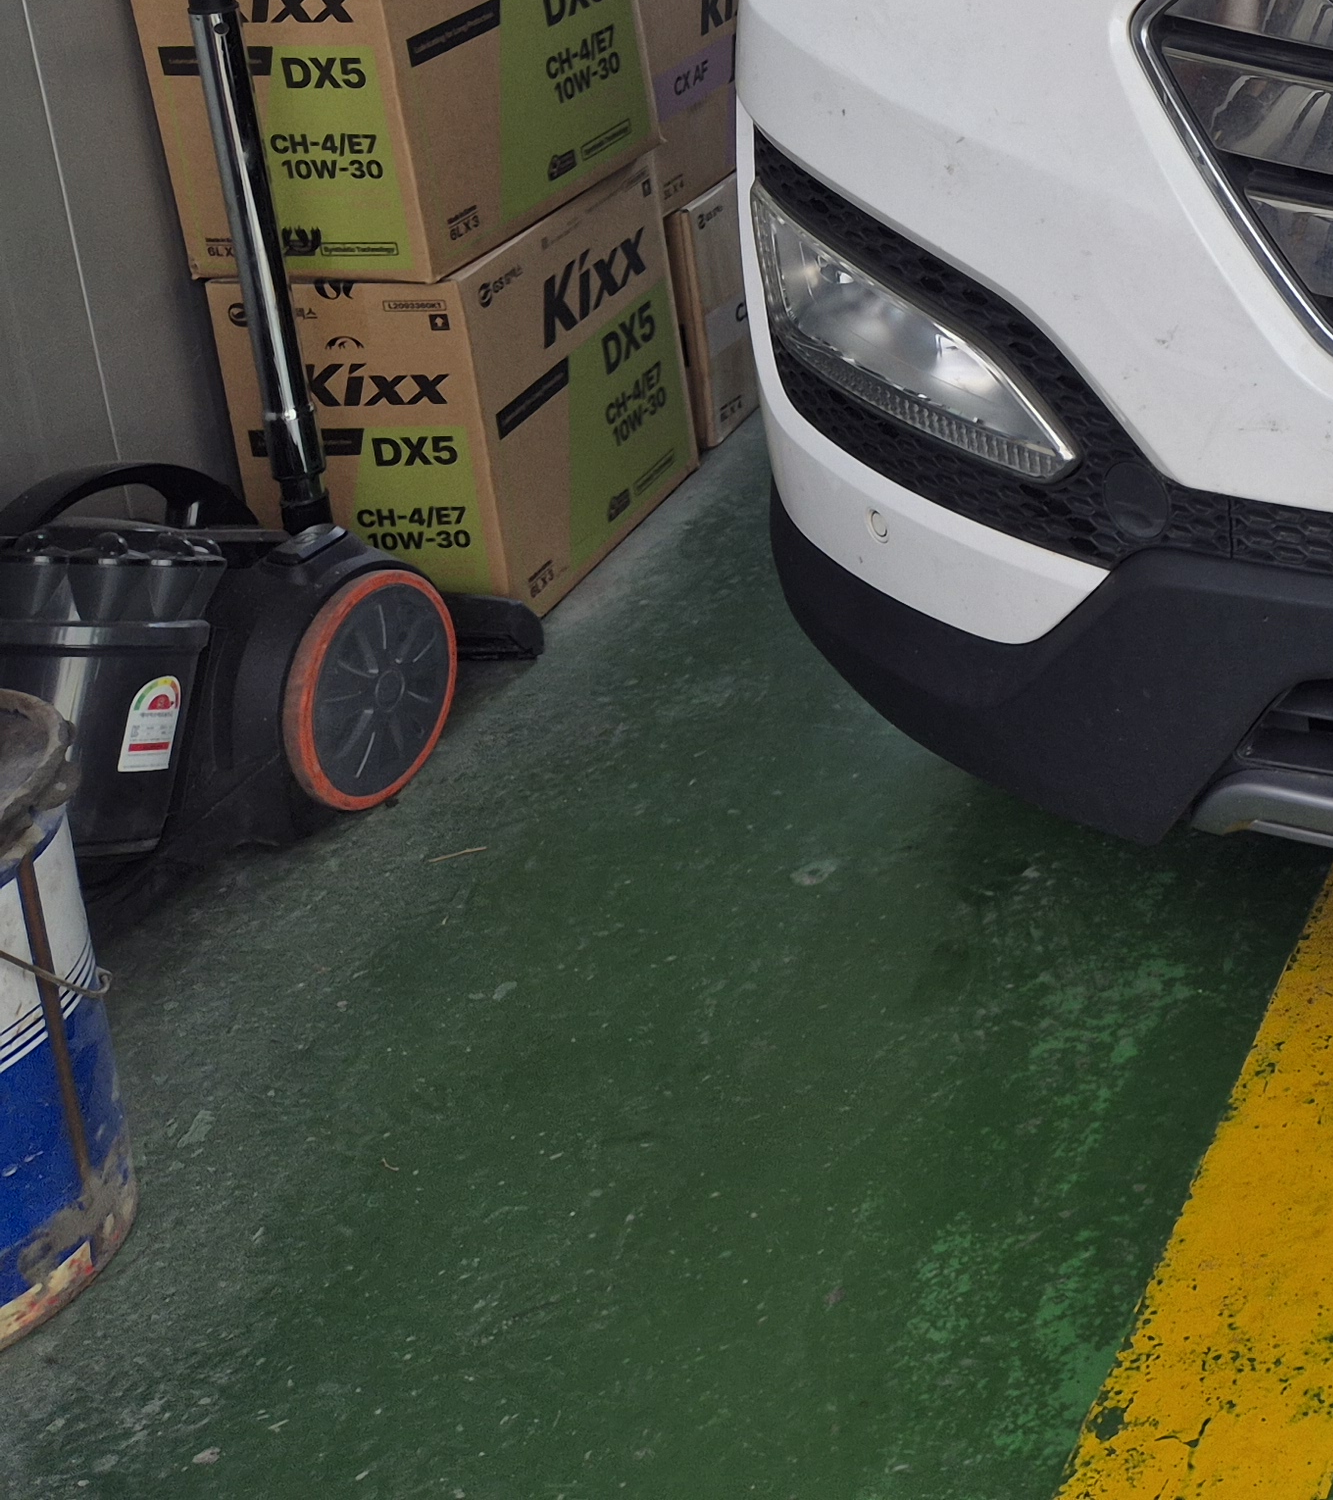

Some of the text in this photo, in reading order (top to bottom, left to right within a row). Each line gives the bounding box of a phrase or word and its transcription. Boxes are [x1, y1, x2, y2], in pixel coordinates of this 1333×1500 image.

[546, 23, 615, 80] CH-4/E7
[280, 56, 367, 90] DX5
[554, 51, 621, 104] 10W-30
[673, 58, 709, 97] CX AF
[270, 132, 377, 157] CH-4/E7
[281, 158, 384, 180] 10W-30
[543, 225, 647, 350] Kixx
[601, 300, 656, 376] DX5
[306, 362, 450, 408] Kixx
[604, 360, 662, 426] CH-4/E7
[611, 385, 667, 447] 10W-30
[371, 435, 458, 467] DX5
[356, 506, 466, 529] CH-4/E7
[368, 529, 471, 552] 10W-30
